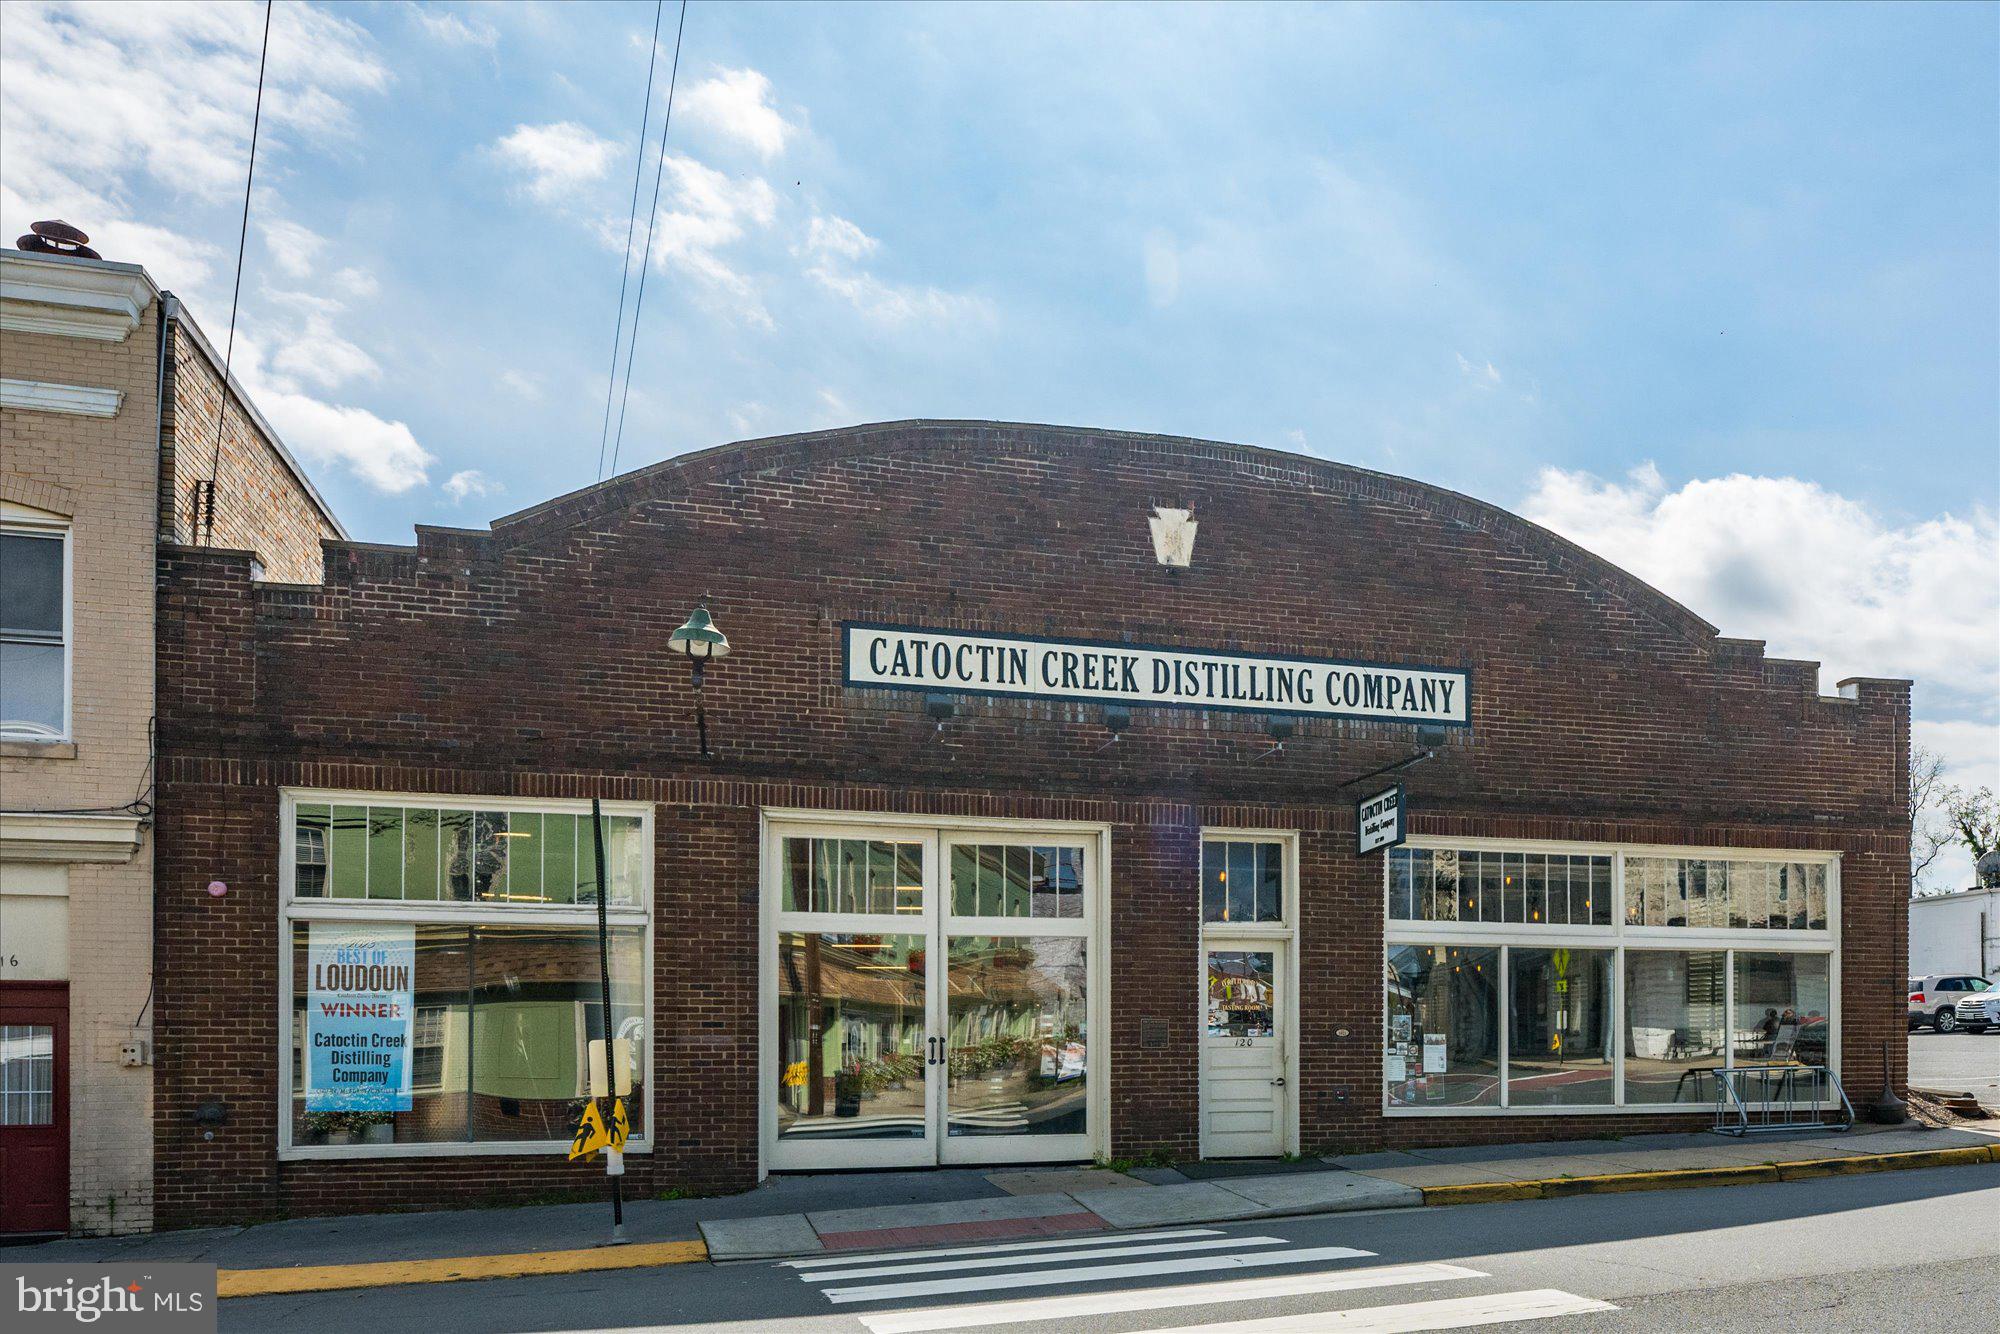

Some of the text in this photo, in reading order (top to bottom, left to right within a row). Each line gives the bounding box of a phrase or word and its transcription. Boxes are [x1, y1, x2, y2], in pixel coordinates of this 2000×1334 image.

[869, 636, 1455, 714] CATOCTIN CREEK DISTILLING COMPANY
[337, 948, 388, 965] BEST OF
[315, 963, 409, 992] LOUDOUN
[320, 1002, 401, 1018] WINNER
[314, 1032, 407, 1048] Catoctin Creek
[1234, 1038, 1253, 1047] 120
[331, 1050, 391, 1068] Distilling
[332, 1068, 389, 1085] Company
